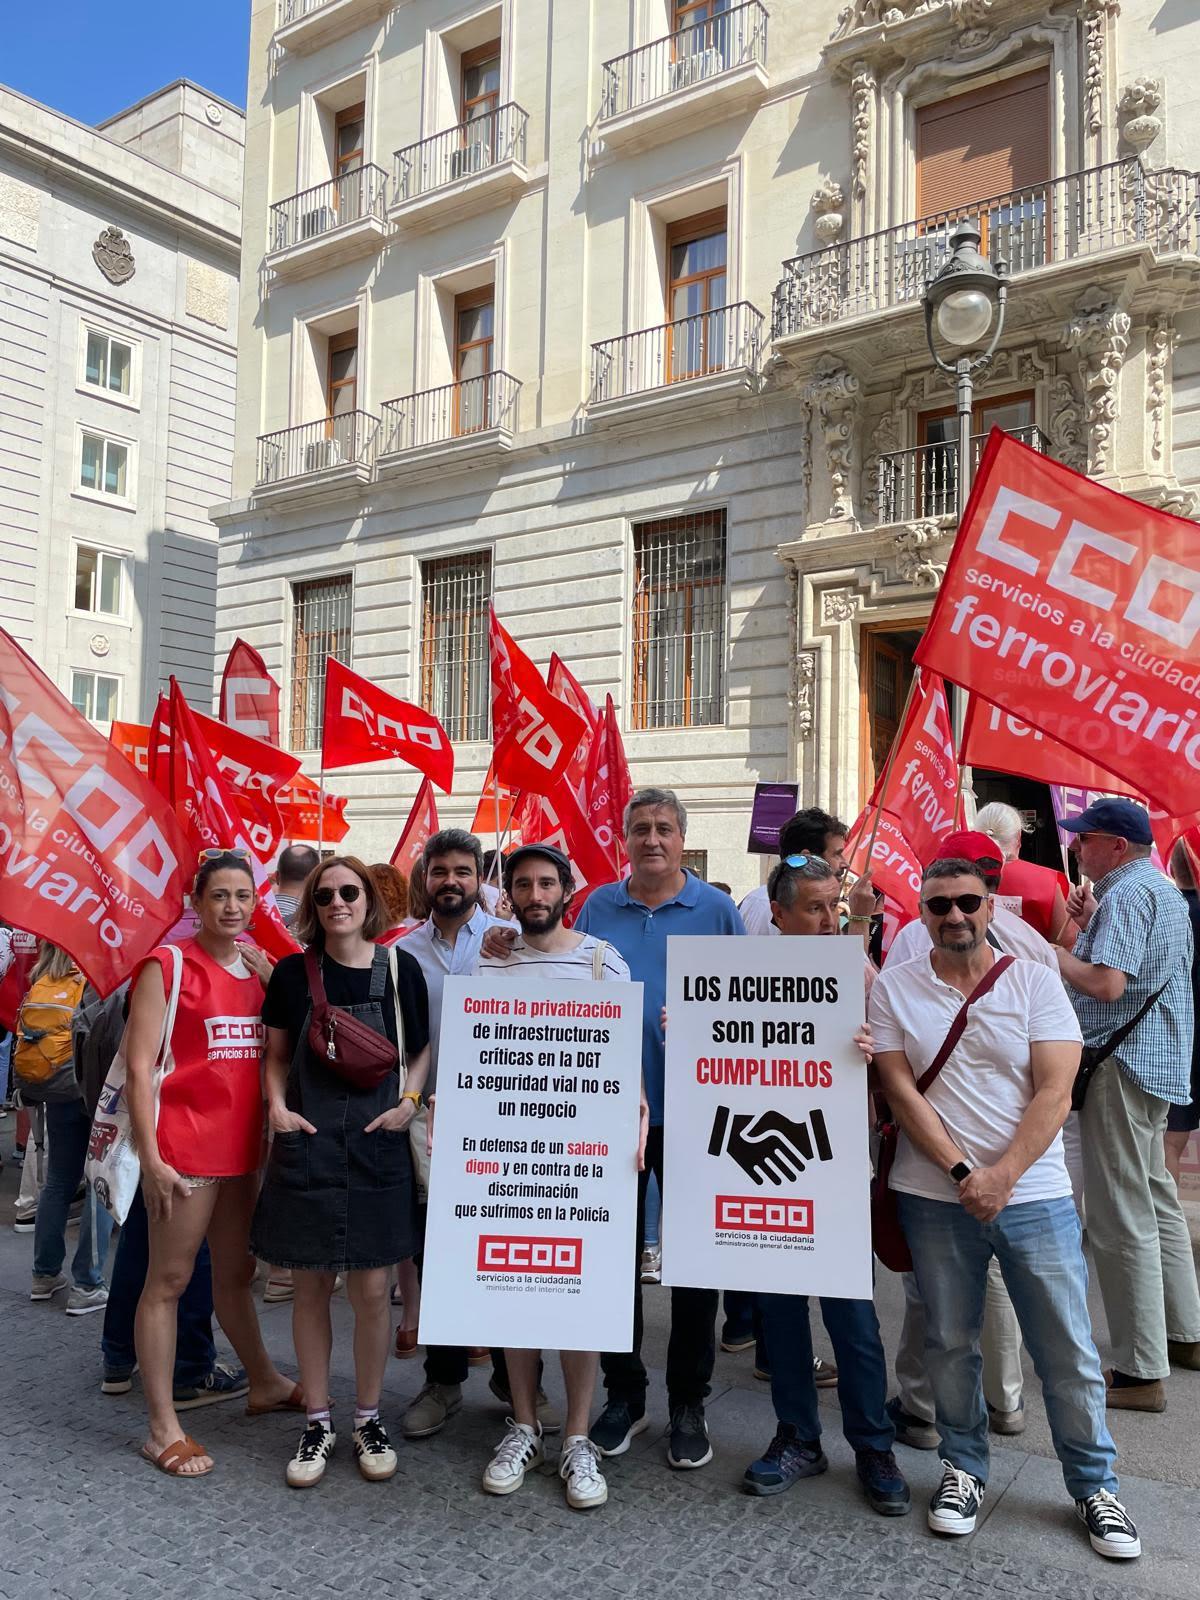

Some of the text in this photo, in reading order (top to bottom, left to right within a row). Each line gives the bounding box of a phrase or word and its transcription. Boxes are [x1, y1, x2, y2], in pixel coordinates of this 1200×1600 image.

[964, 568, 1065, 625] servicios
[1069, 618, 1086, 636] a
[1090, 623, 1115, 649] la
[26, 808, 49, 832] la
[52, 826, 145, 918] ciudadanía
[683, 975, 839, 1004] LOS ACUERDOS
[464, 997, 621, 1019] Contra la privatización
[211, 1023, 264, 1040] CCOO
[473, 1023, 610, 1043] de infraestructuras
[712, 1020, 815, 1048] son para
[208, 1048, 243, 1060] servicios
[244, 1050, 250, 1059] a
[250, 1048, 257, 1059] la
[479, 1047, 601, 1068] críticas en la DGT
[696, 1057, 833, 1088] CUMPLIRLOS
[457, 1073, 620, 1094] La seguridad vial no es
[498, 1101, 577, 1118] un negocio
[463, 1137, 609, 1156] En defensa de un salario
[466, 1159, 603, 1178] digno y en contra de la
[488, 1182, 578, 1199] discriminación
[455, 1203, 610, 1222] que sufrimos en la Policía
[722, 1202, 808, 1227] CCOO
[715, 1231, 751, 1240] servicios
[760, 1233, 768, 1241] la
[769, 1233, 815, 1244] ciudadanía
[715, 1240, 759, 1248] administración
[484, 1242, 576, 1267] CCOO
[476, 1273, 515, 1283] servicios
[524, 1274, 532, 1283] la
[534, 1275, 582, 1285] ciudadanía
[486, 1284, 523, 1292] ministerio
[525, 1285, 536, 1293] del
[538, 1286, 566, 1294] interior
